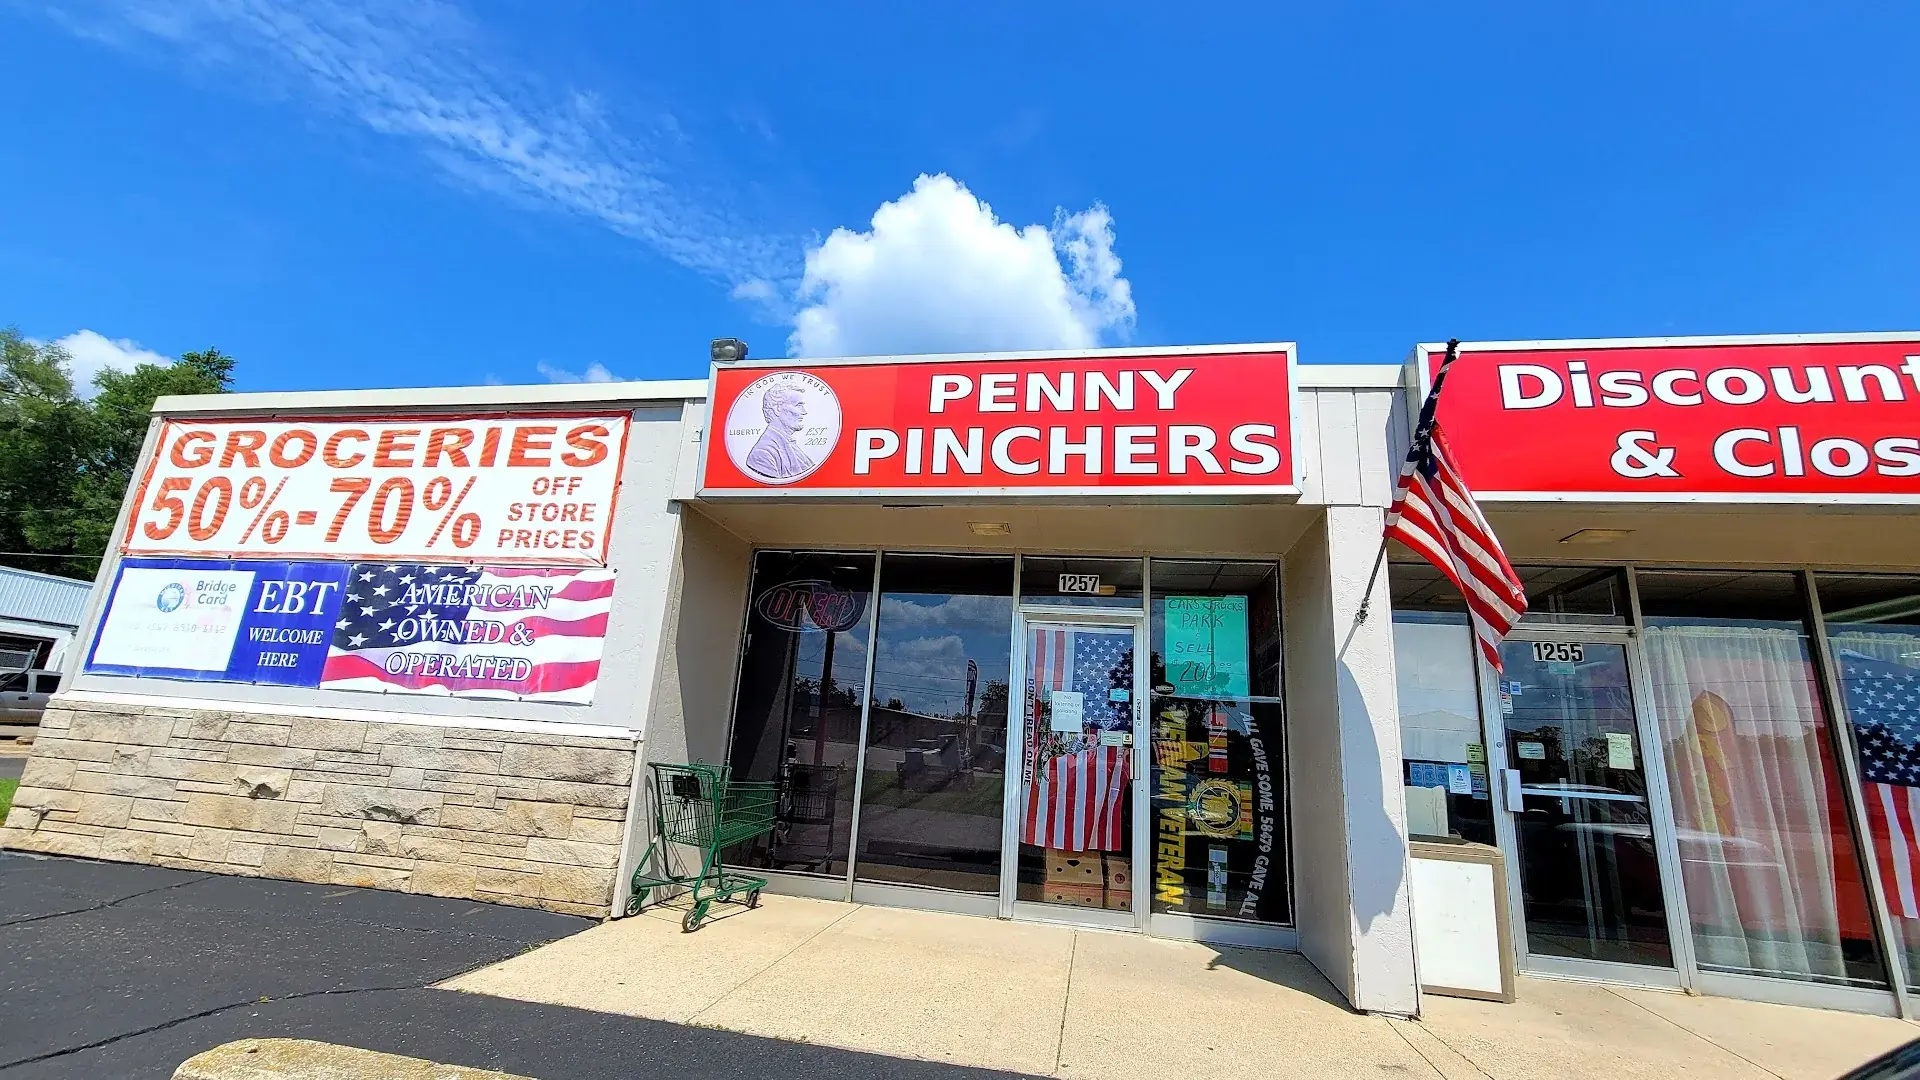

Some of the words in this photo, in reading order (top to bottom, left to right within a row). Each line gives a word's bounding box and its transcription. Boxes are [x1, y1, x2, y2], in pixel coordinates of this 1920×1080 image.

[744, 389, 754, 398] IN
[755, 377, 774, 389] GOD
[802, 376, 830, 397] TRUST
[929, 368, 1197, 413] PENNY
[729, 428, 761, 436] LIBERTY
[804, 437, 828, 446] 2013
[806, 427, 828, 436] EST
[170, 425, 610, 469] GROCERIES
[853, 423, 1282, 476] PINCHERS
[1609, 426, 1684, 479] &
[532, 476, 583, 496] OFF
[508, 502, 597, 522] STORE
[497, 528, 596, 549] PRICES
[196, 580, 237, 594] Bridge
[400, 582, 553, 609] AMERICAN
[1060, 575, 1099, 592] 1257
[197, 593, 228, 605] Card
[254, 581, 338, 615] EBT
[767, 587, 849, 627] OPEN
[1168, 599, 1200, 611] CARS
[396, 617, 505, 644] OWNED
[508, 622, 535, 646] &
[1181, 612, 1224, 628] PARK
[249, 627, 324, 645] WELCOME
[1174, 641, 1215, 653] SELL
[257, 651, 299, 668] HERE
[1533, 642, 1583, 661] 1255
[385, 651, 533, 682] OPERATED
[1027, 678, 1035, 708] DON'T
[1026, 712, 1035, 748] TREAD
[1239, 711, 1260, 736] ALL
[1026, 752, 1033, 766] ON
[1159, 709, 1187, 801] VIENAM
[1249, 737, 1270, 772] GAVE
[1023, 769, 1032, 786] ME
[1256, 773, 1274, 812] SOME,
[1258, 815, 1274, 853] 58479
[1155, 807, 1187, 906] VETERAN
[1248, 855, 1270, 891] GAVE
[1238, 890, 1259, 916] ALL
